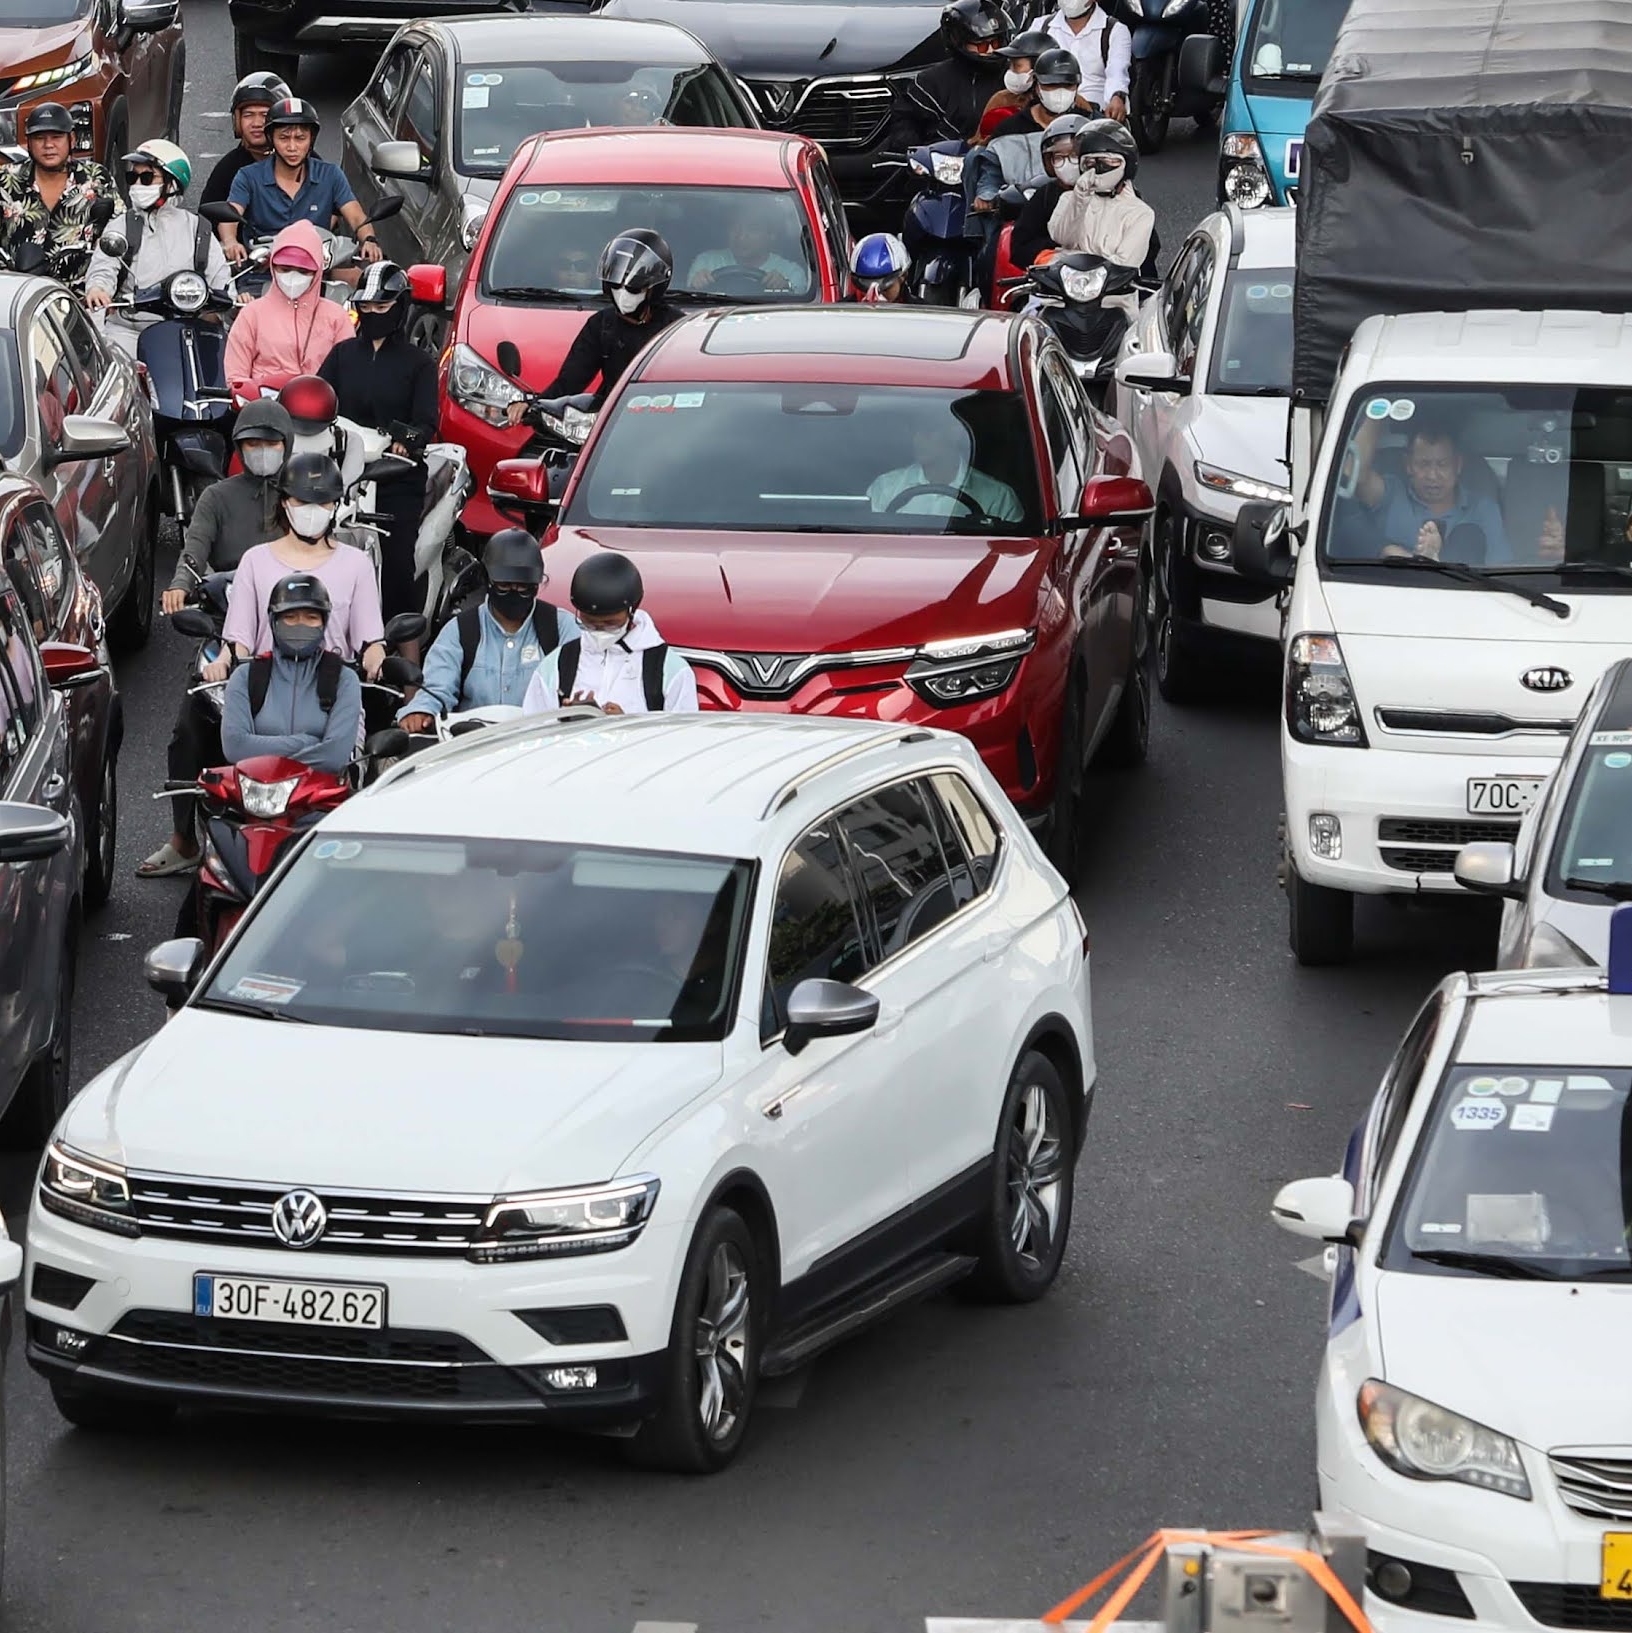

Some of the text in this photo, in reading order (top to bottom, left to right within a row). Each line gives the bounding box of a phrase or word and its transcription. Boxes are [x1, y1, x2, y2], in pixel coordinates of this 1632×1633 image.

[1527, 670, 1567, 688] KIA
[1456, 1106, 1502, 1121] 1335
[195, 1303, 212, 1317] EU
[217, 1282, 378, 1326] 30F-482.62
